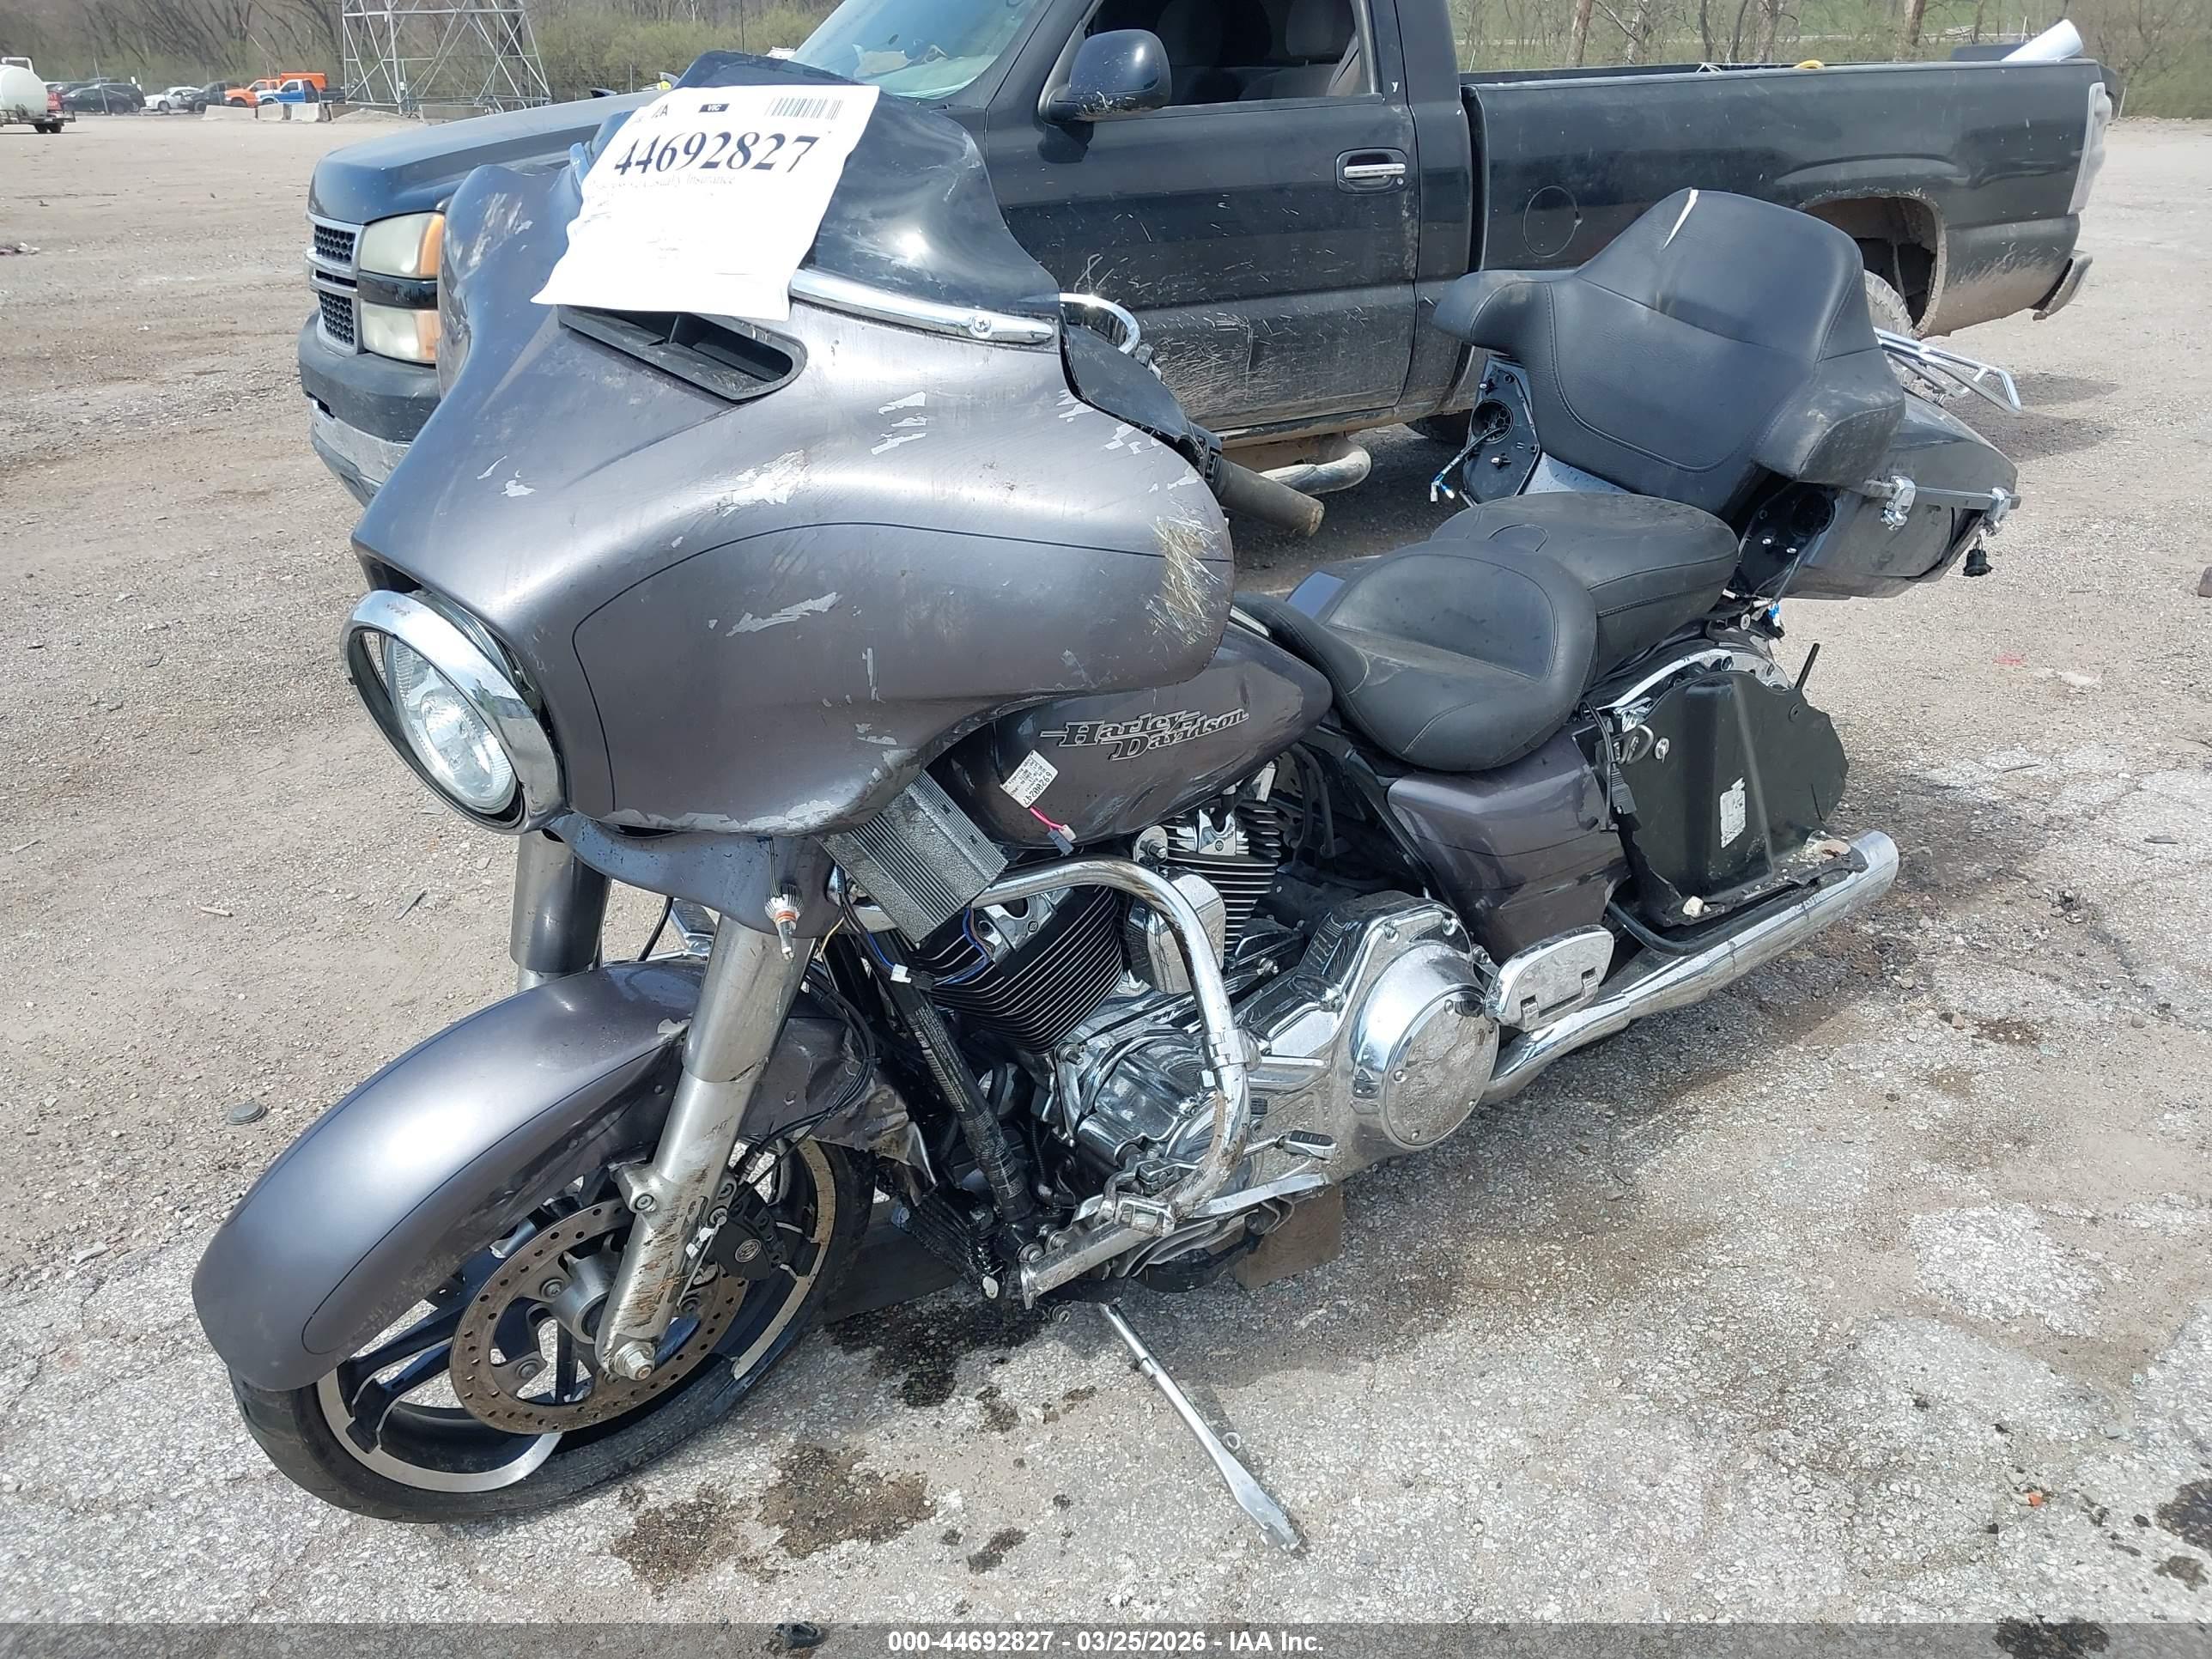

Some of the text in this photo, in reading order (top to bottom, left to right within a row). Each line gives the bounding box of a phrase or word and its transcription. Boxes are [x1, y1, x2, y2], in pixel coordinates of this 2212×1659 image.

[614, 131, 819, 175] 44692827
[1040, 710, 1200, 747] Harley
[1102, 708, 1249, 761] Davidson
